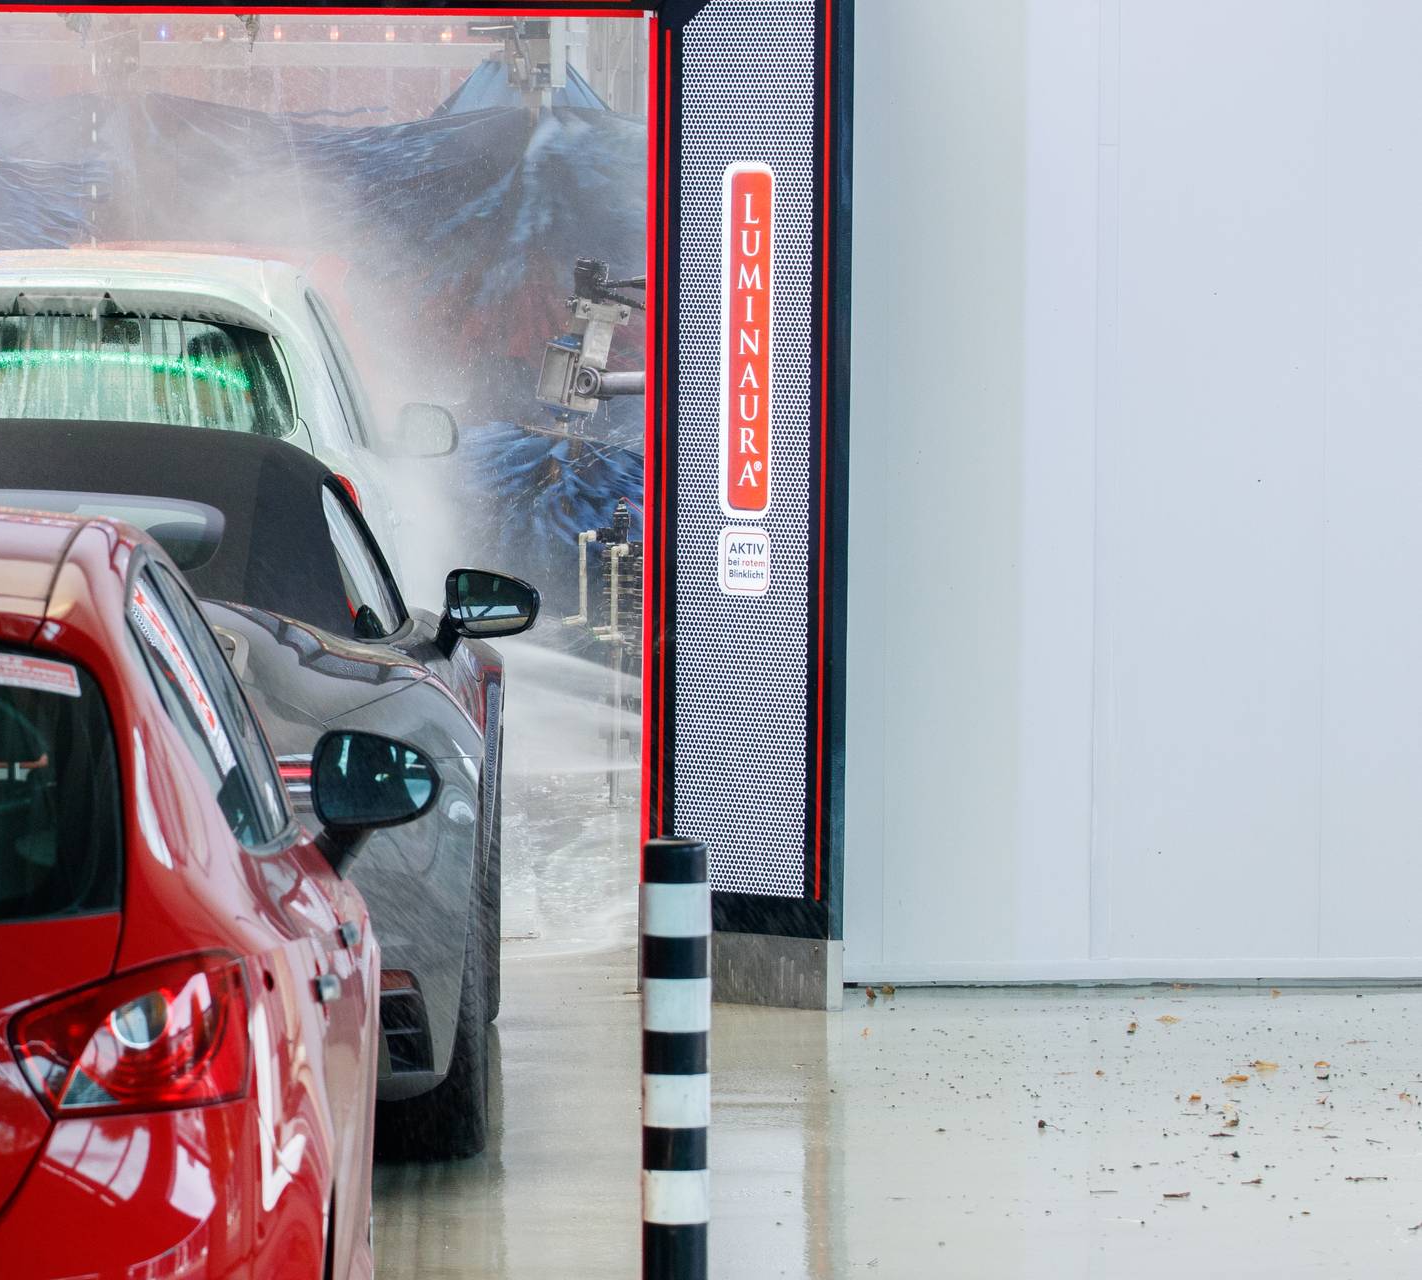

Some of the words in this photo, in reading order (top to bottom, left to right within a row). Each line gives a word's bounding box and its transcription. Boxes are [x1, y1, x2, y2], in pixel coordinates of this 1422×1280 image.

[729, 542, 765, 555] AKTIV
[727, 557, 740, 566] bei
[742, 559, 766, 568] rotem
[728, 569, 764, 580] Blinklicht
